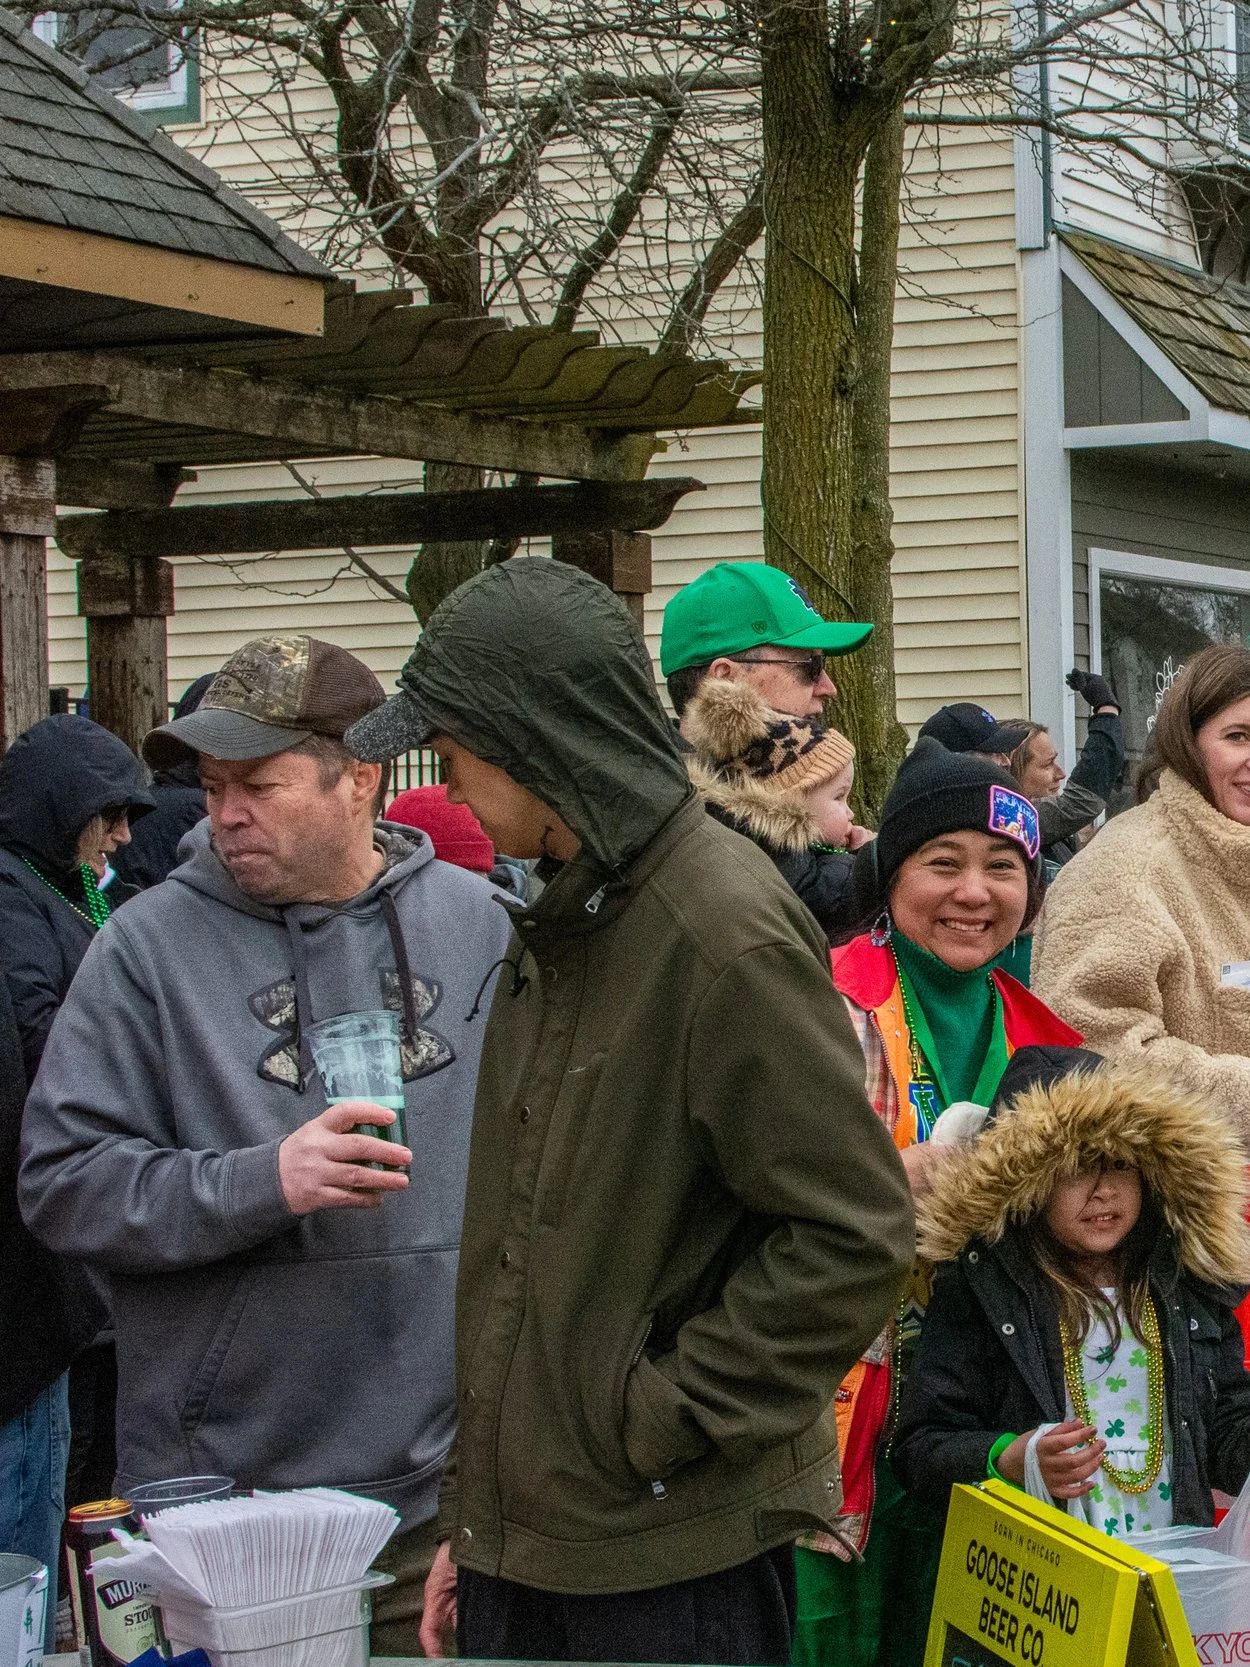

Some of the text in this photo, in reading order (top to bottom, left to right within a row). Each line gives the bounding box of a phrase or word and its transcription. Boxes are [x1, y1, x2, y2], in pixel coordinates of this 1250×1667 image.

[993, 1521, 1061, 1567] BORN IN CHICAGO
[966, 1539, 1080, 1636] GOOSE ISLAND
[978, 1596, 1019, 1653] BEER
